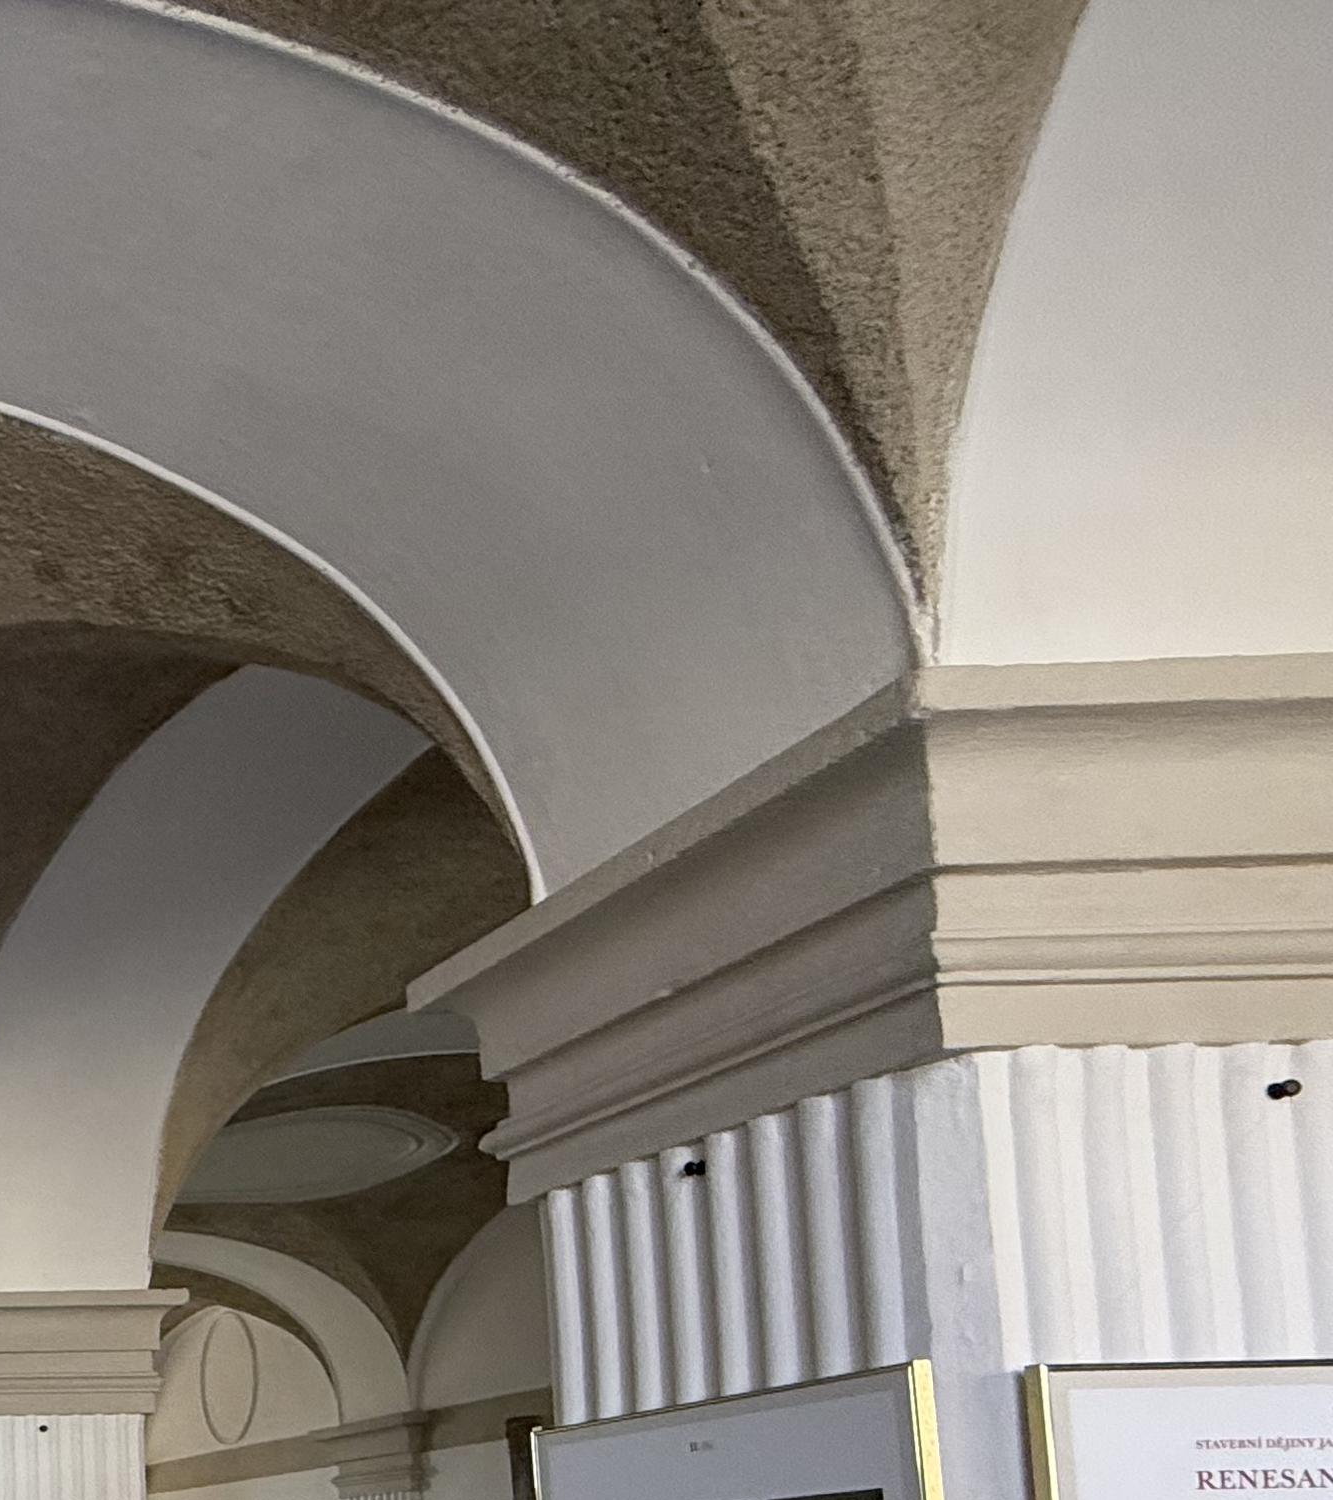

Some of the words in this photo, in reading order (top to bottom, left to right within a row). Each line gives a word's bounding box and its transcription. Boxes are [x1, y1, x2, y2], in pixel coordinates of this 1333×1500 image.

[1196, 1436, 1261, 1449] STAVEBNÍ
[1266, 1437, 1317, 1451] DĚJINY
[1196, 1468, 1333, 1490] RENESAN
